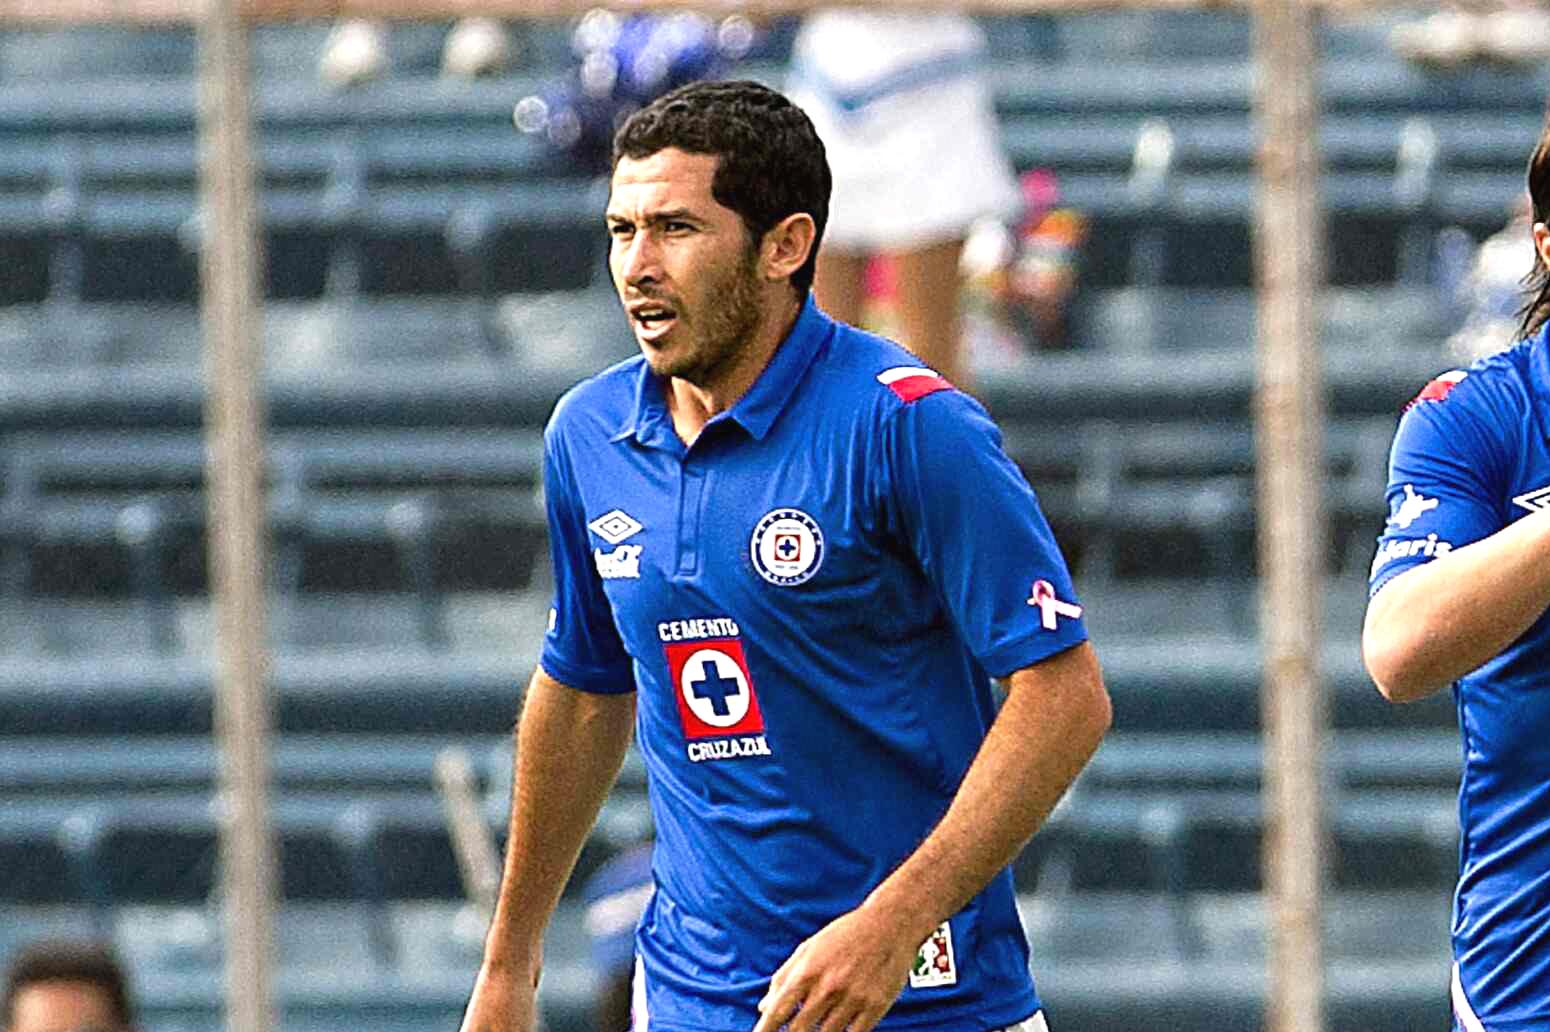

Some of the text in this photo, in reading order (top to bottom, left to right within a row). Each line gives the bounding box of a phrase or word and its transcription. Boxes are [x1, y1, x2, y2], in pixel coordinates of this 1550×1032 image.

[1374, 532, 1453, 572] laris
[658, 618, 740, 642] CEMENTO
[687, 736, 772, 762] CRUZAZUL
